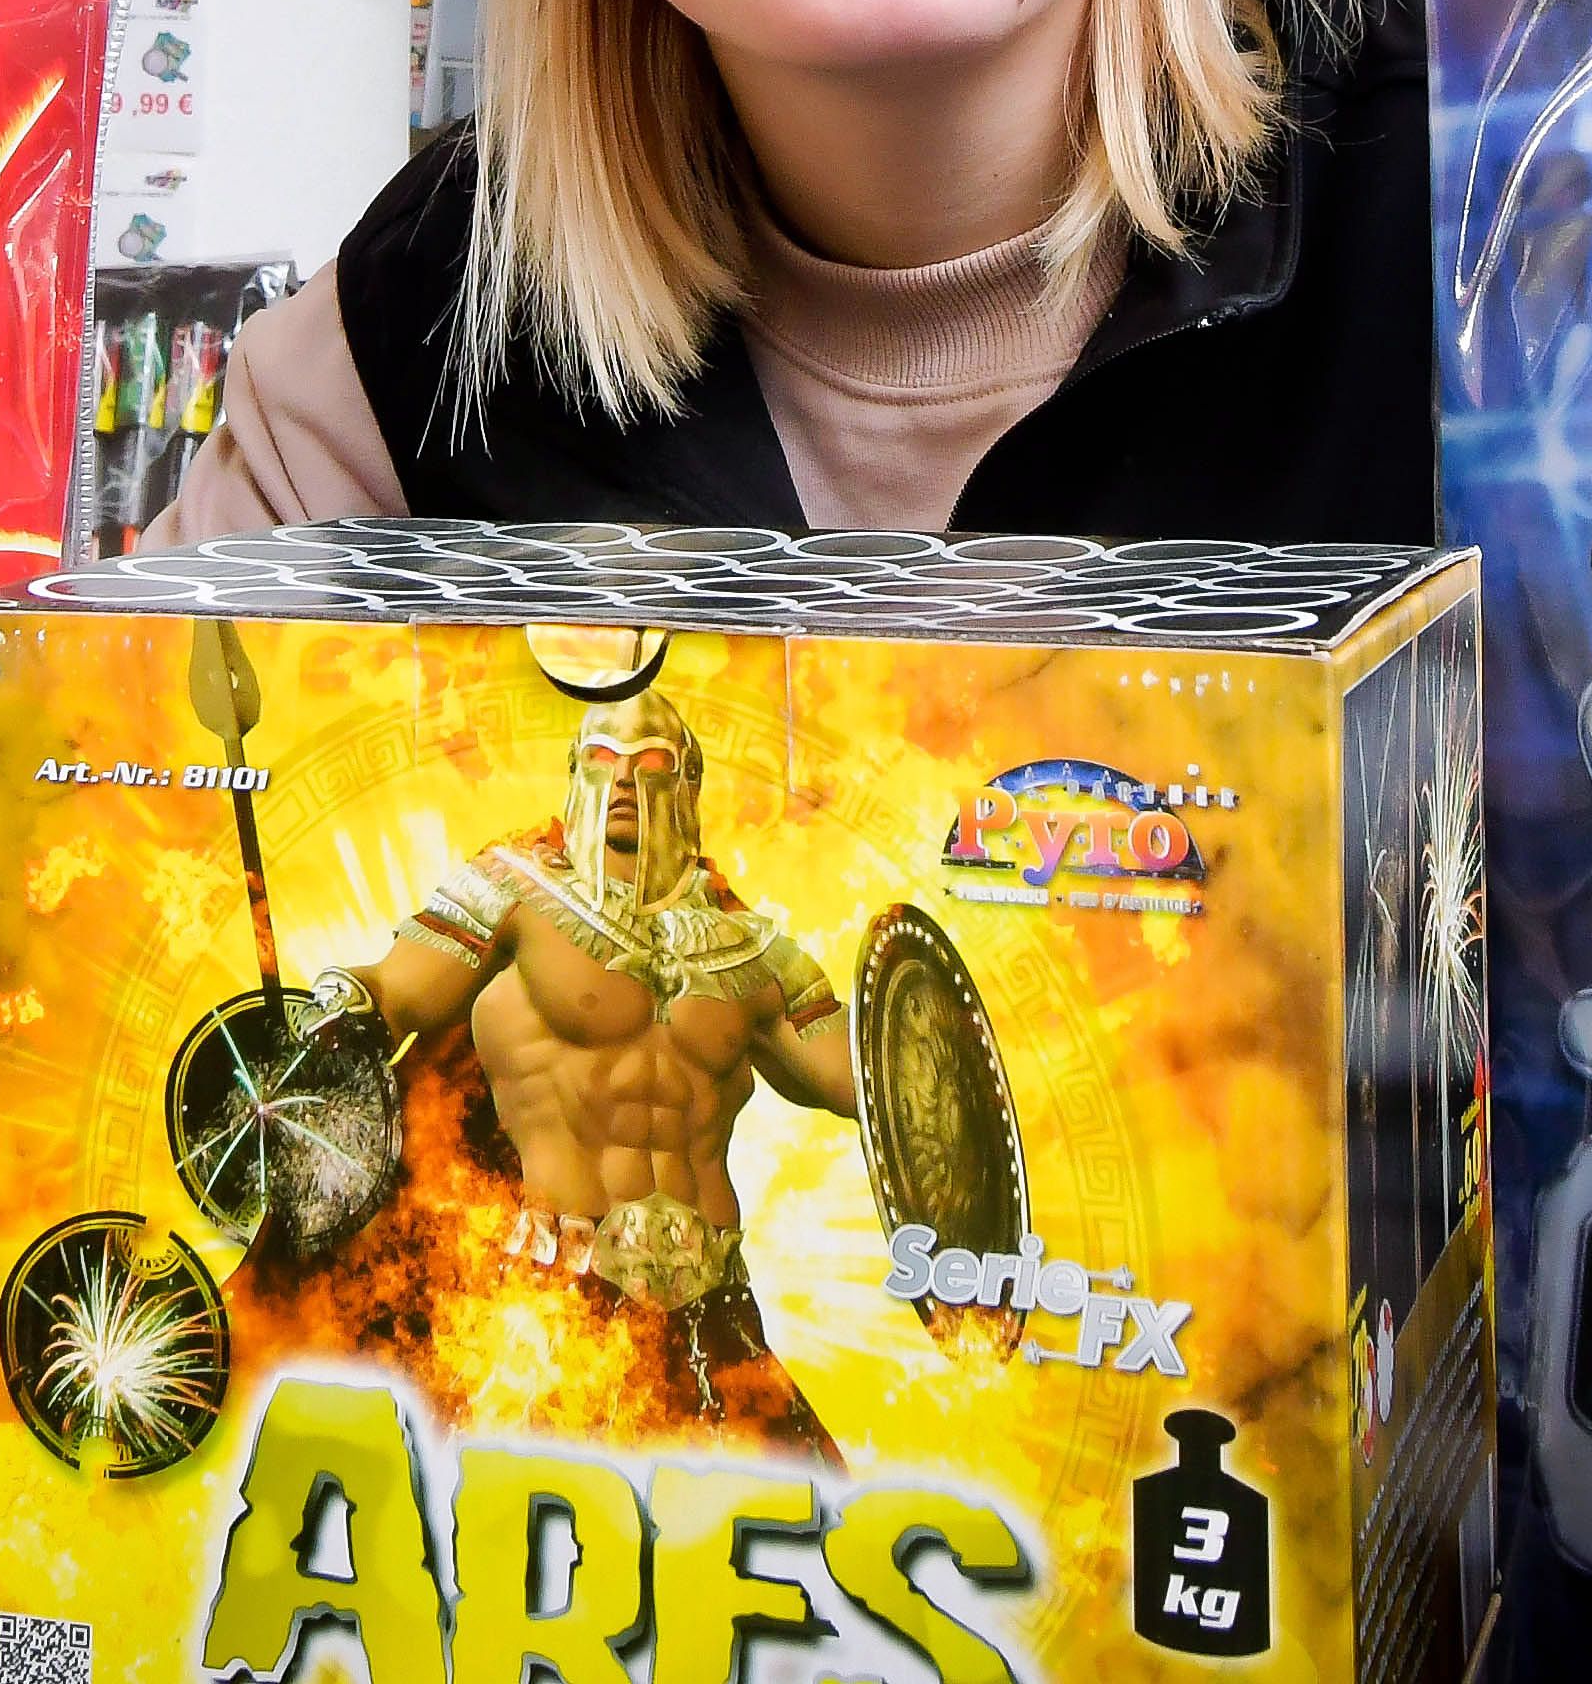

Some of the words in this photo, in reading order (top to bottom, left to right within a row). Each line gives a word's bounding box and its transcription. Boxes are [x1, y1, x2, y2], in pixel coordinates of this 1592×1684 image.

[35, 757, 170, 787] Art.-Nr.:
[183, 767, 270, 791] 81101
[951, 786, 1190, 886] Pyro
[884, 1223, 1090, 1316] Serie
[1076, 1295, 1196, 1377] FX
[1174, 1508, 1230, 1565] 3
[1162, 1580, 1242, 1631] kg
